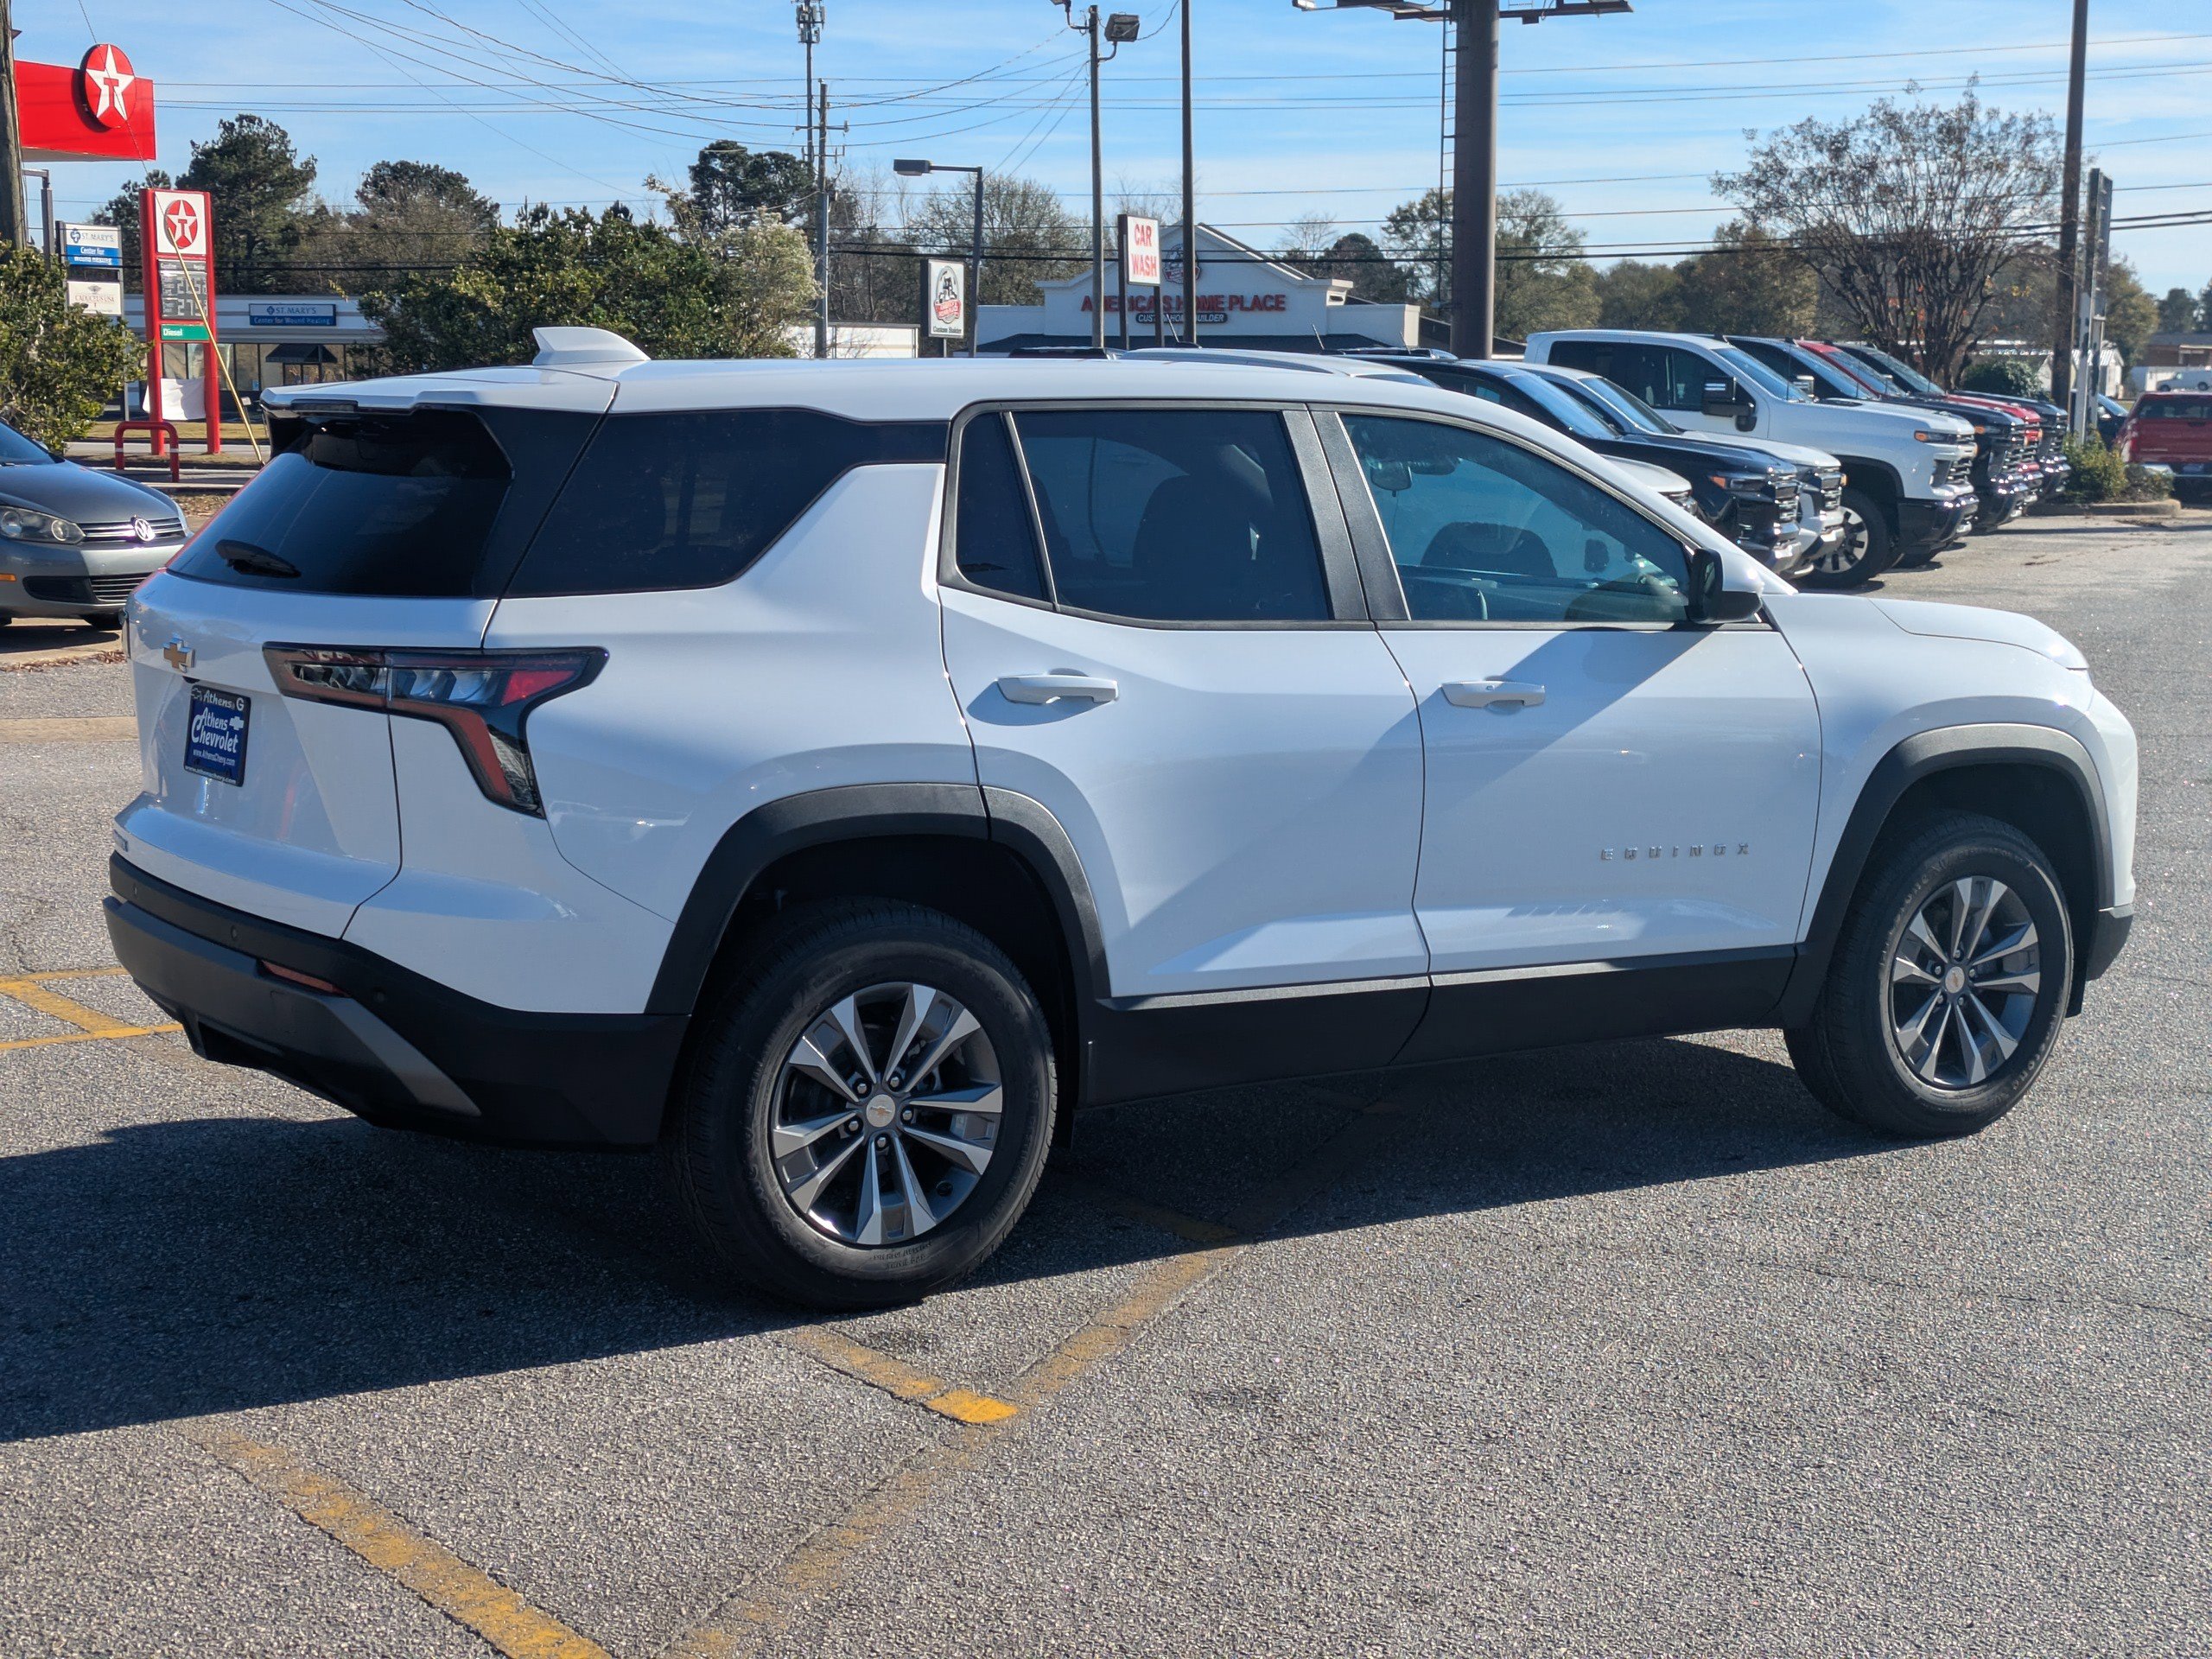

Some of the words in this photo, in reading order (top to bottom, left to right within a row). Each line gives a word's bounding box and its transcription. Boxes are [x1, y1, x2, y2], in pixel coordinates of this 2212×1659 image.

[1135, 224, 1152, 247] CAR
[1131, 253, 1157, 276] WASH
[1228, 295, 1286, 311] PLACE
[203, 690, 232, 709] Athens
[202, 707, 228, 730] Athens
[191, 714, 238, 753] Chevrolet
[1600, 842, 1749, 861] EQUINOX
